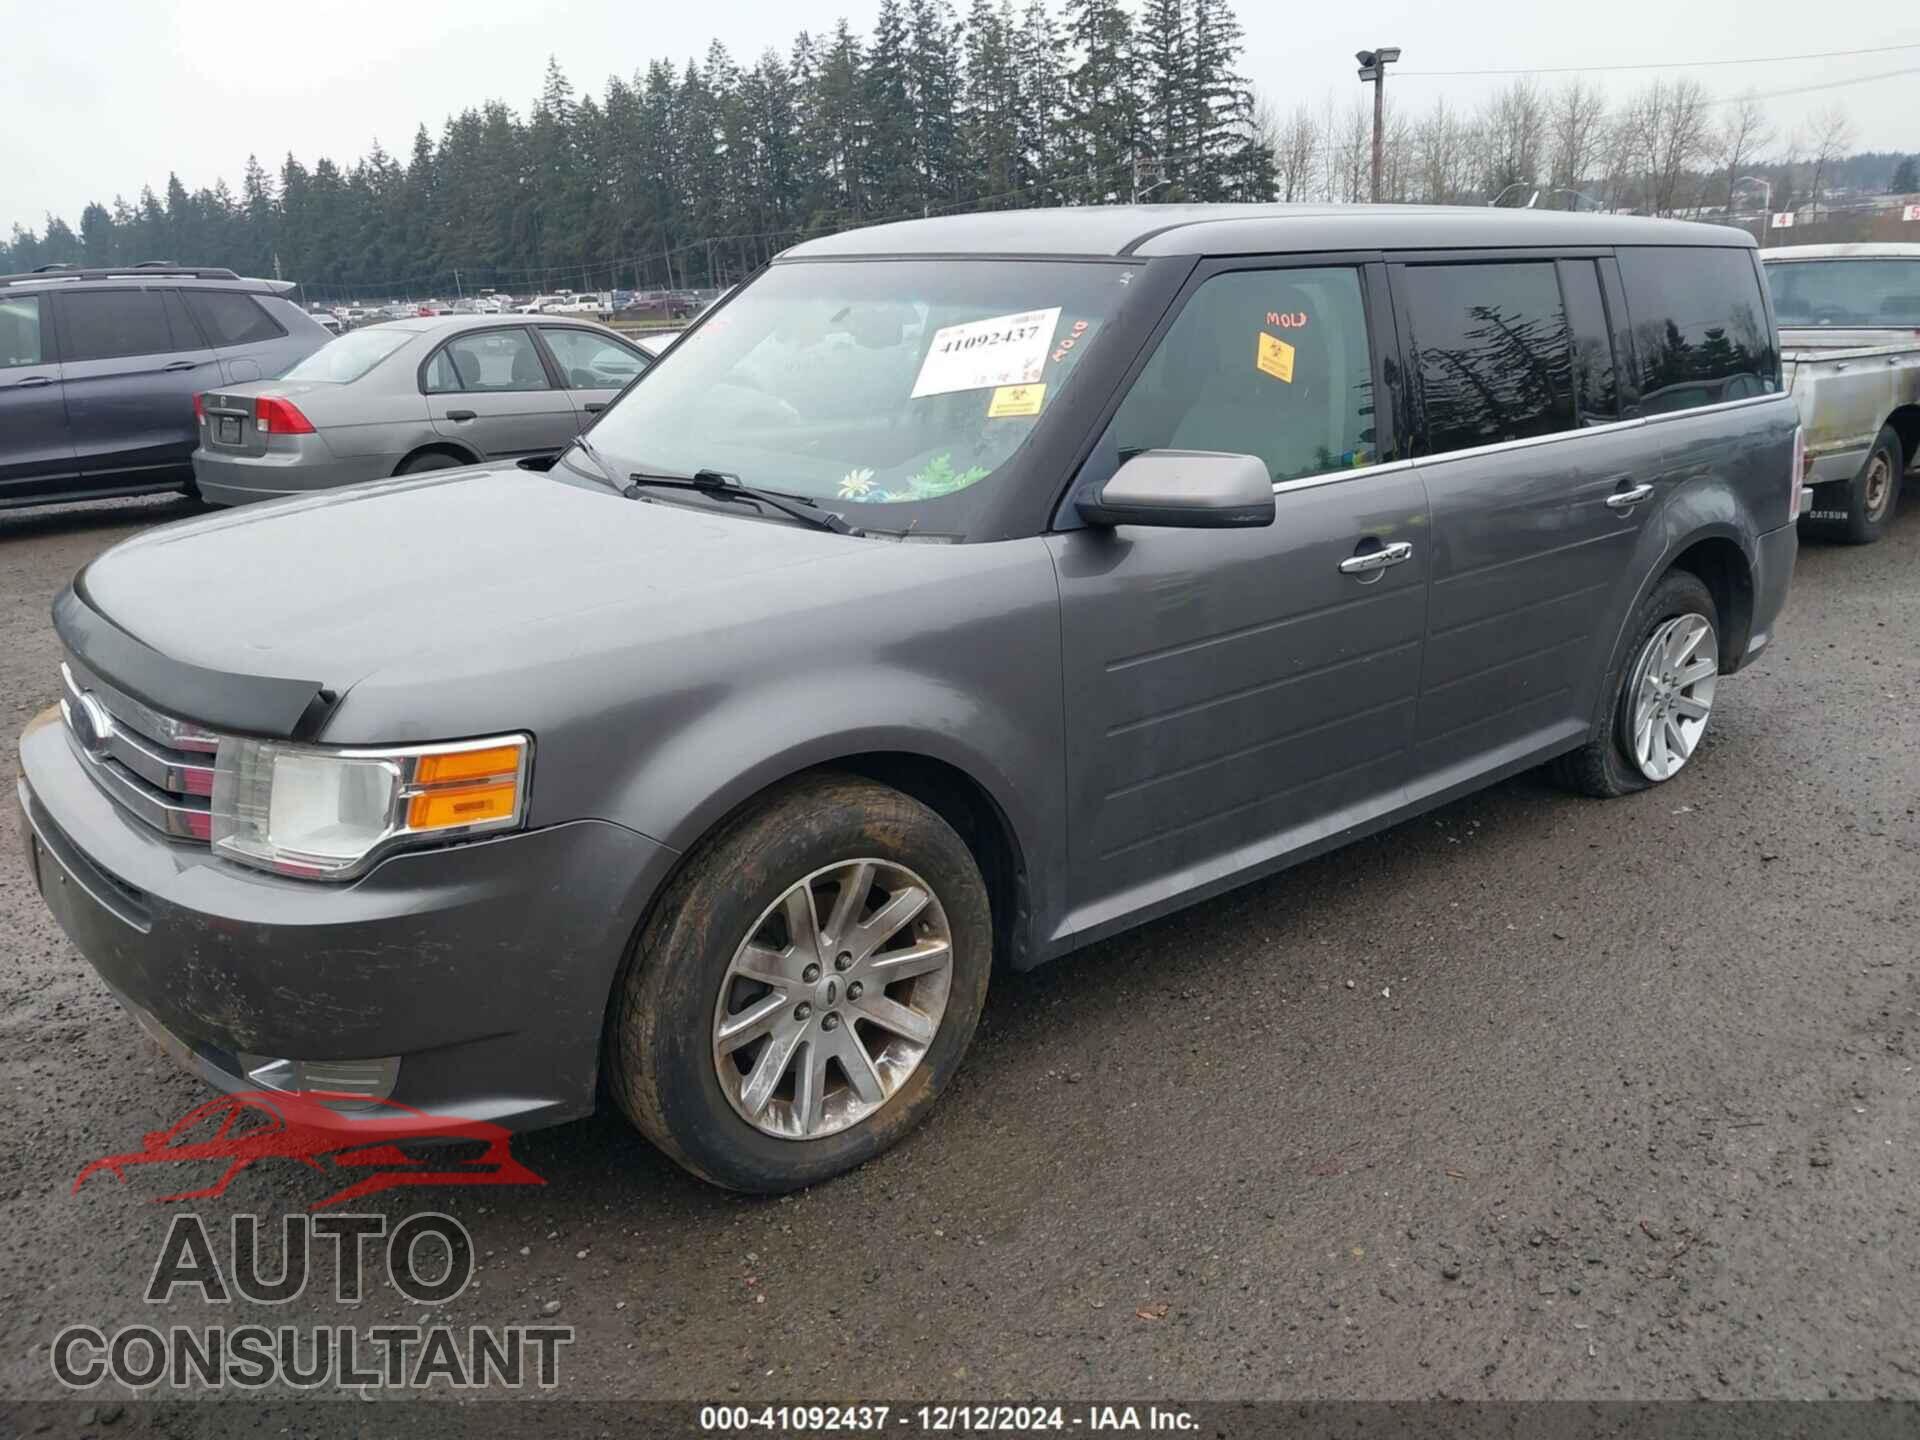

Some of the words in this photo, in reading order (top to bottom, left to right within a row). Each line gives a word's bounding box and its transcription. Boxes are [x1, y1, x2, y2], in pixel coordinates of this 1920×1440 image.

[1265, 311, 1308, 328] MOLD
[939, 325, 1040, 354] 41092437
[1810, 510, 1848, 520] DATSUN
